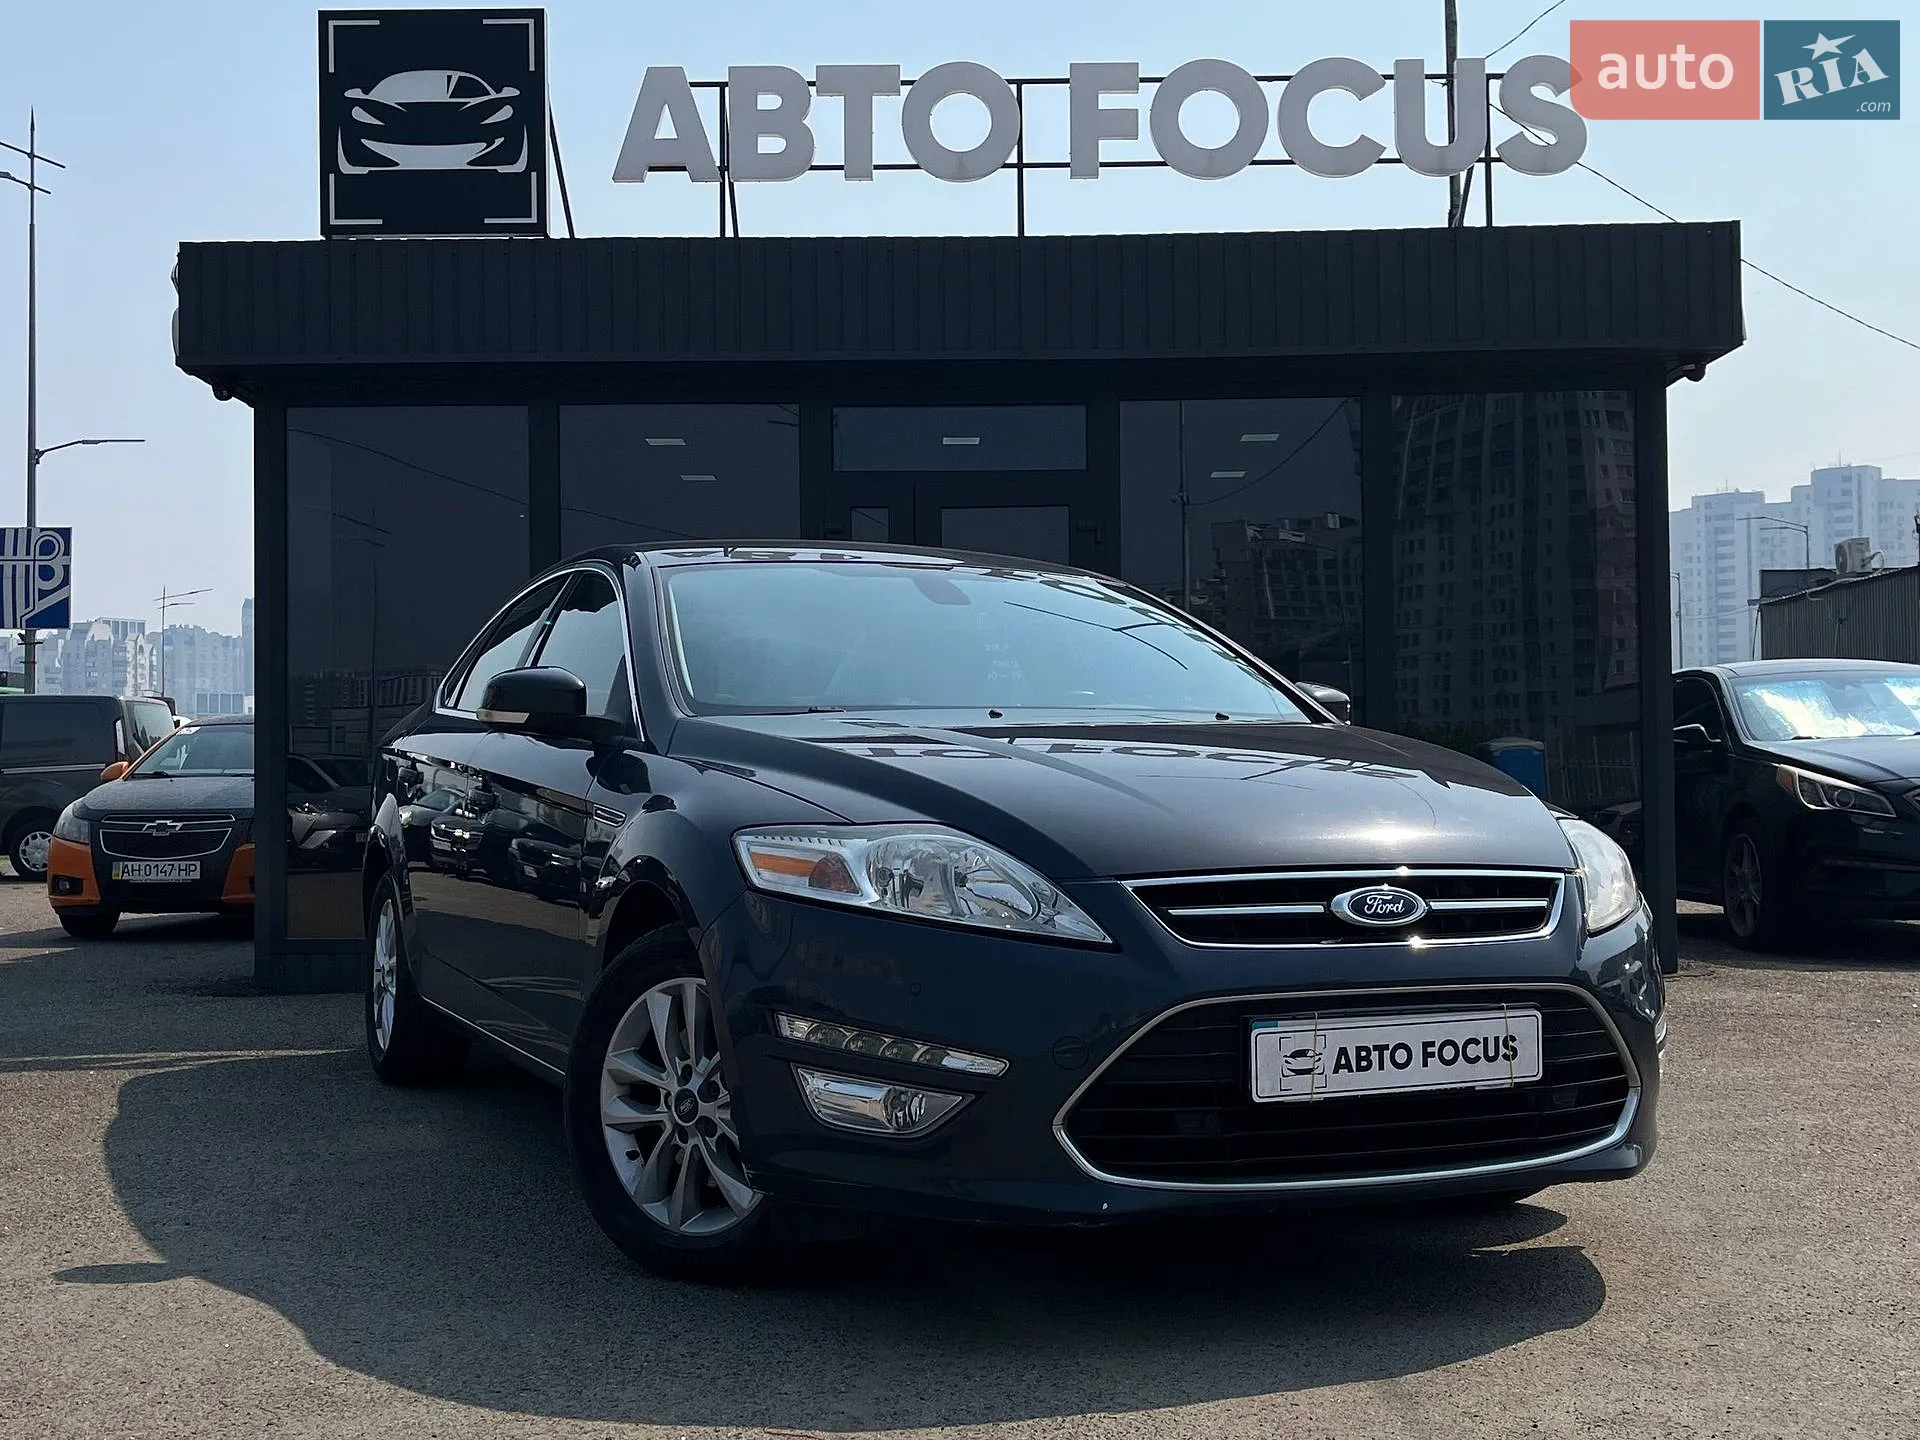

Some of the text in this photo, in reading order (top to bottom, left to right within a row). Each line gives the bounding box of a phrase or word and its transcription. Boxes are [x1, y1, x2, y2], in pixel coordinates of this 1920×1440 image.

[1069, 55, 1588, 181] FOCUS
[1364, 895, 1405, 915] Ford
[1421, 1033, 1519, 1069] FOCUS
